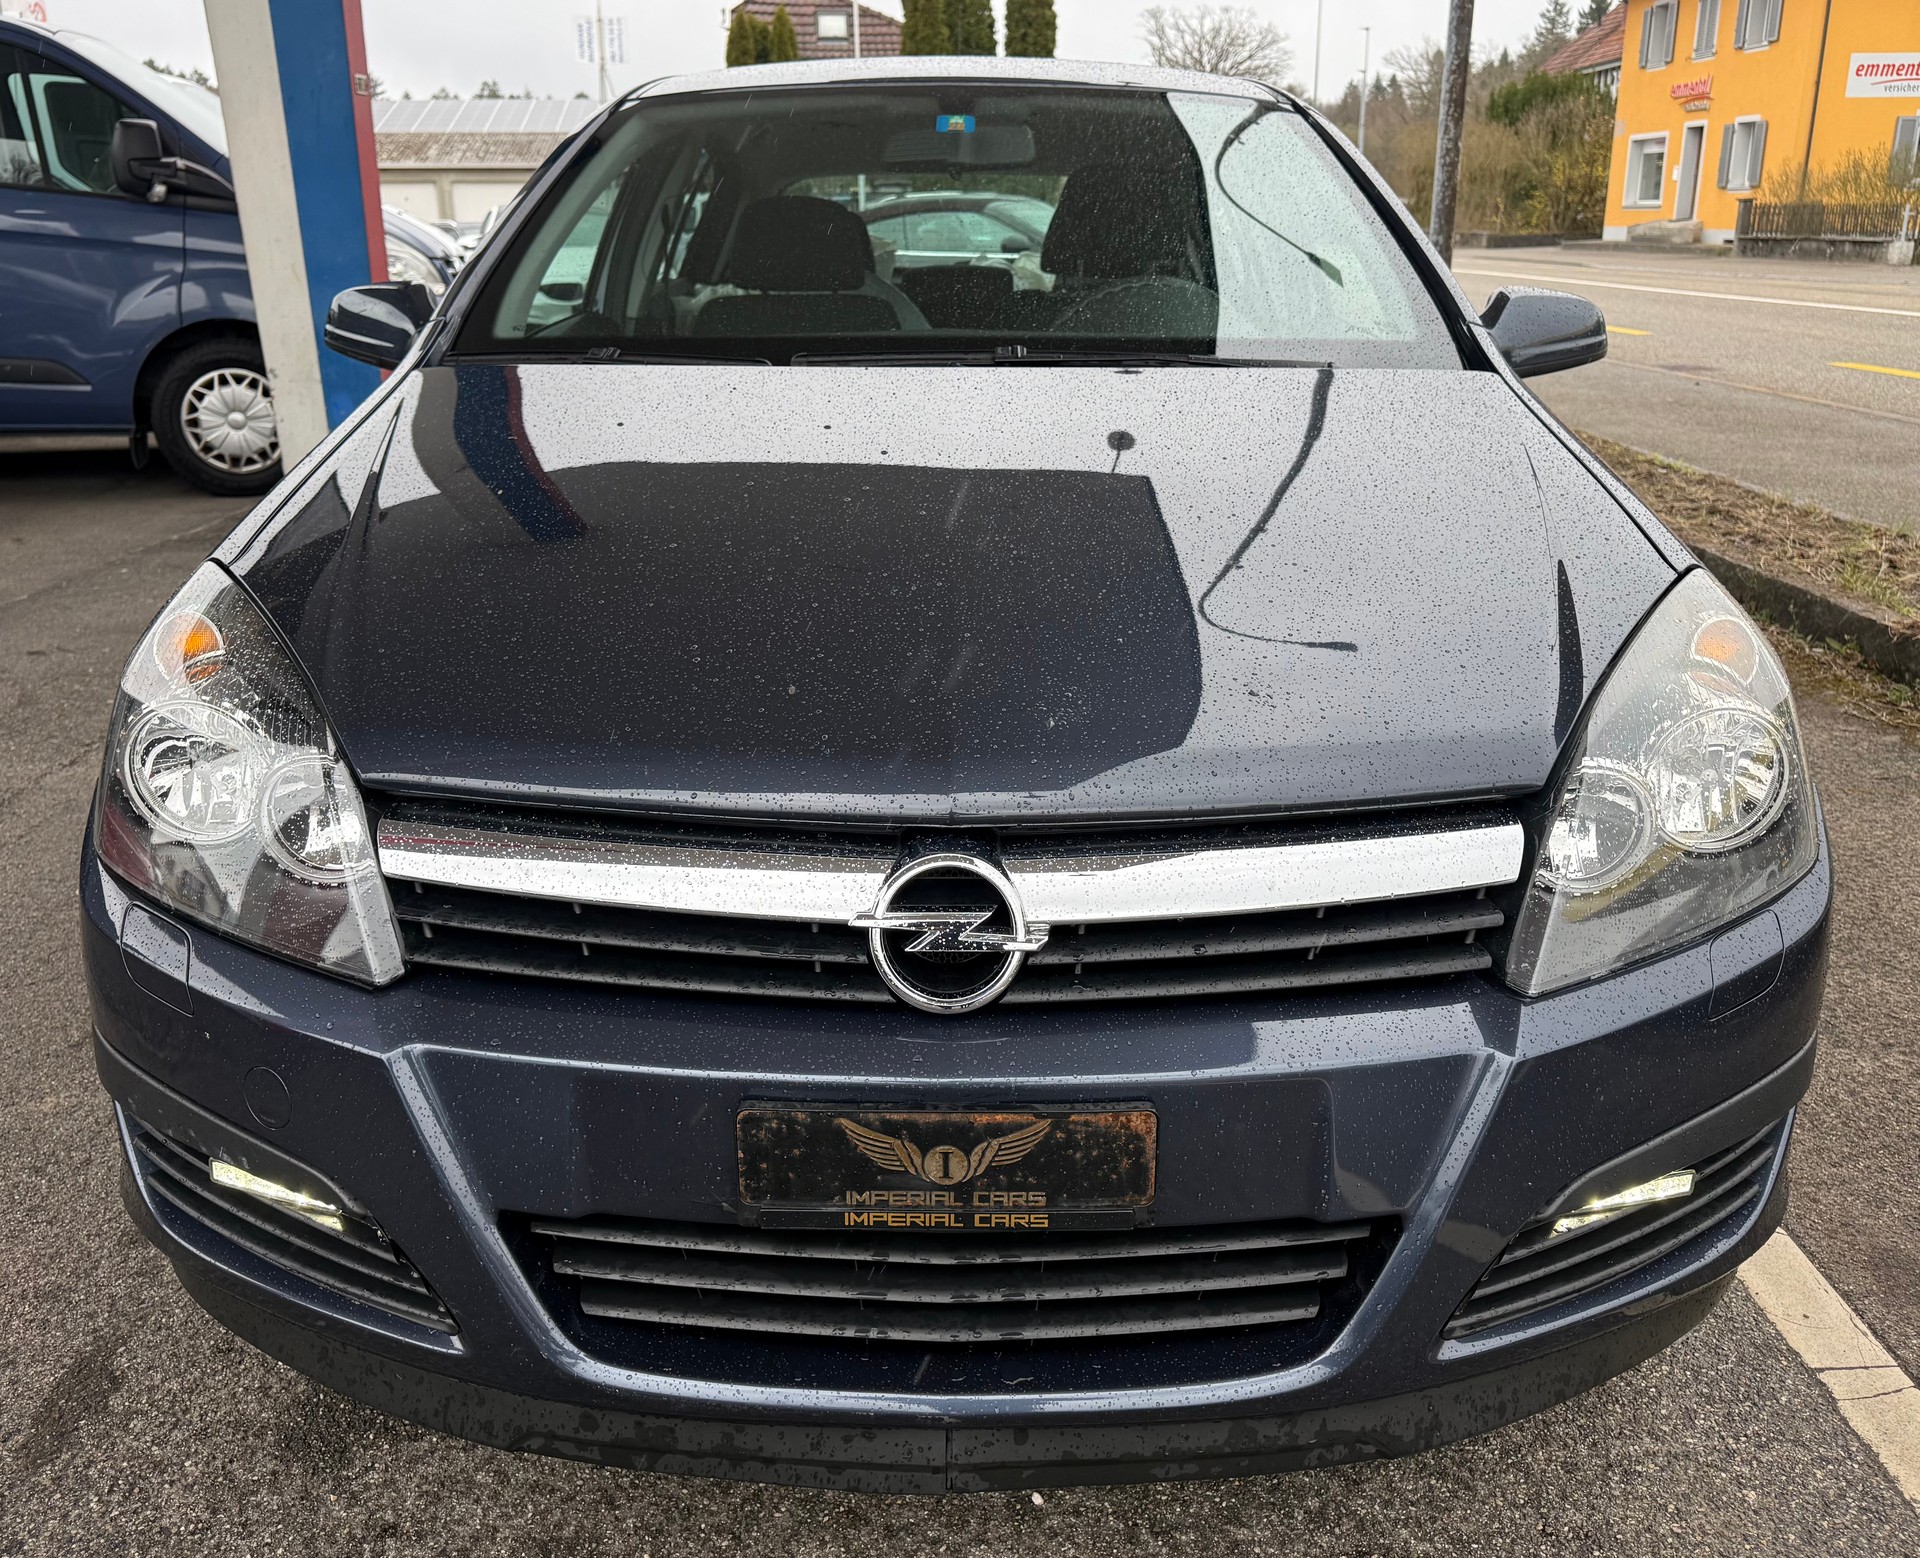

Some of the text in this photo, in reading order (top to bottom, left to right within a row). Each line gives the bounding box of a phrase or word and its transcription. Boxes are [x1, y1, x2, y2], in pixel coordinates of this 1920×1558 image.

[845, 1190, 1047, 1207] IMPERIAL CARS
[844, 1212, 1049, 1228] IMPERIAL CARS
